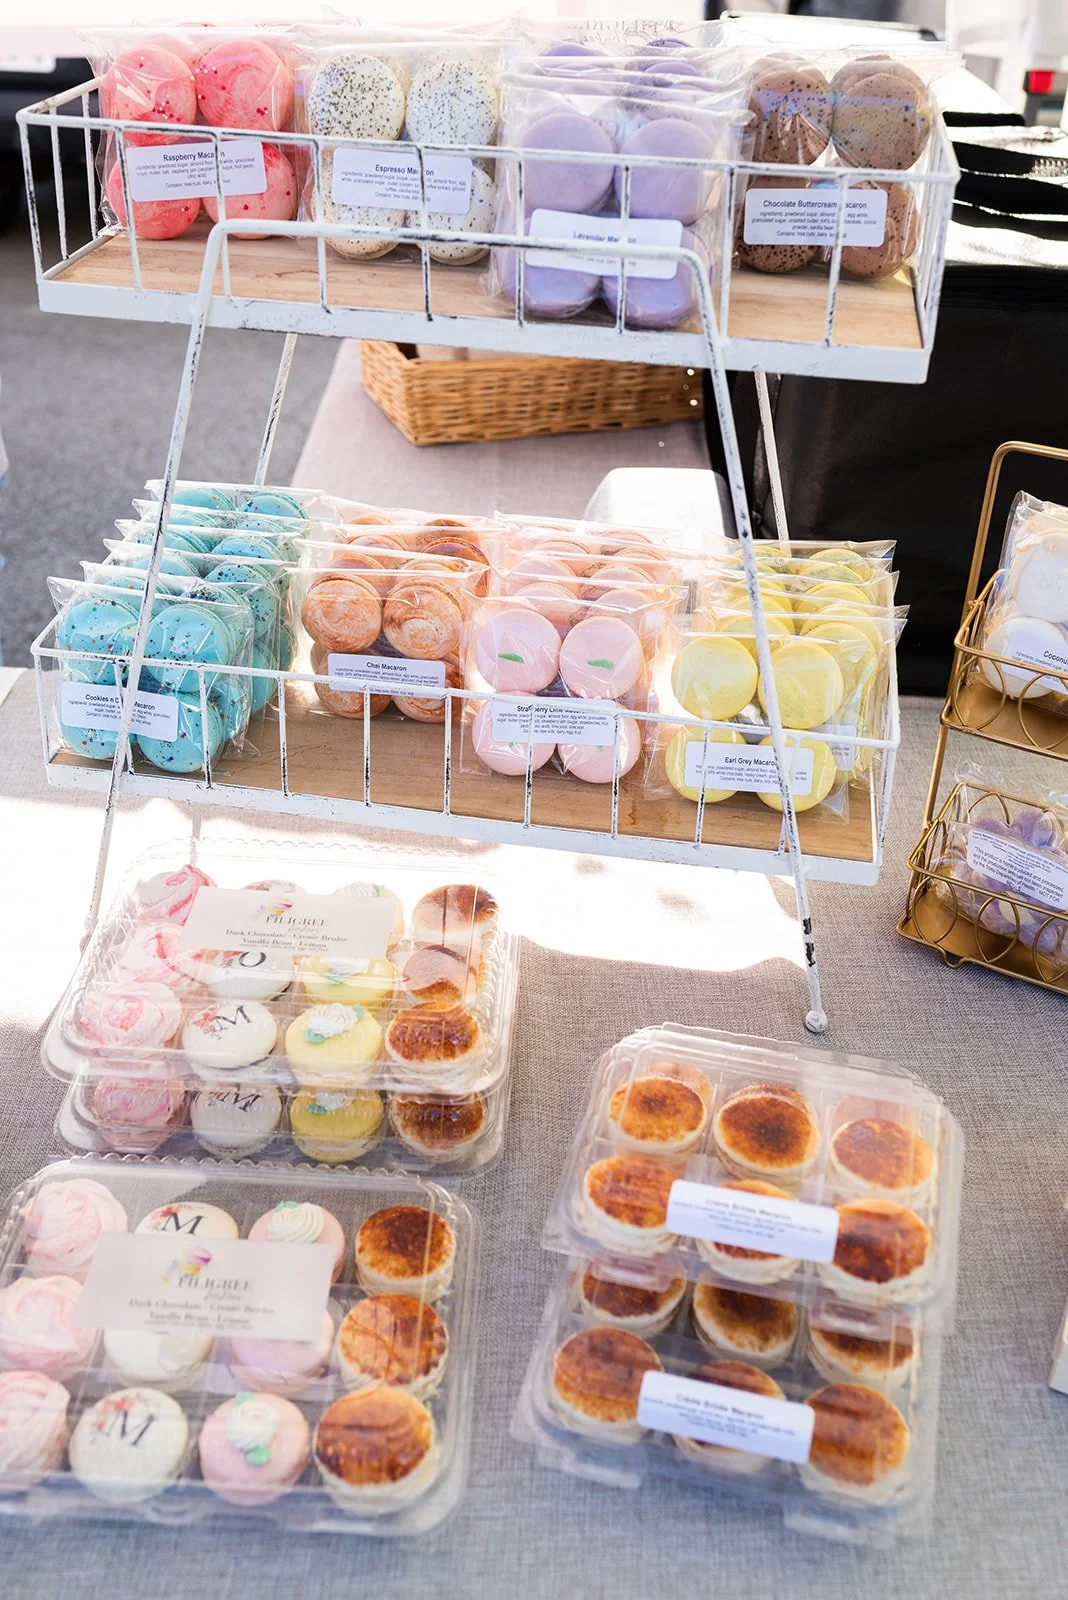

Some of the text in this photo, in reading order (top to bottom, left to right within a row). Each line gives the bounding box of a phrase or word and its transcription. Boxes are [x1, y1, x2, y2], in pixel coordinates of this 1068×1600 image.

[163, 152, 196, 164] Raspberry
[198, 149, 226, 160] Macan
[375, 164, 406, 174] Espresso
[573, 232, 606, 242] Lavender
[1044, 649, 1068, 665] Coconu
[366, 662, 408, 672] Chai Macaron
[85, 694, 110, 703] Cookies
[516, 705, 548, 714] Straerry
[738, 758, 752, 766] Grey
[753, 758, 776, 766] Macaro
[226, 929, 245, 937] Dark
[247, 931, 287, 939] Chocolate
[216, 1005, 252, 1032] M
[161, 1212, 206, 1235] M
[106, 1410, 157, 1447] M
